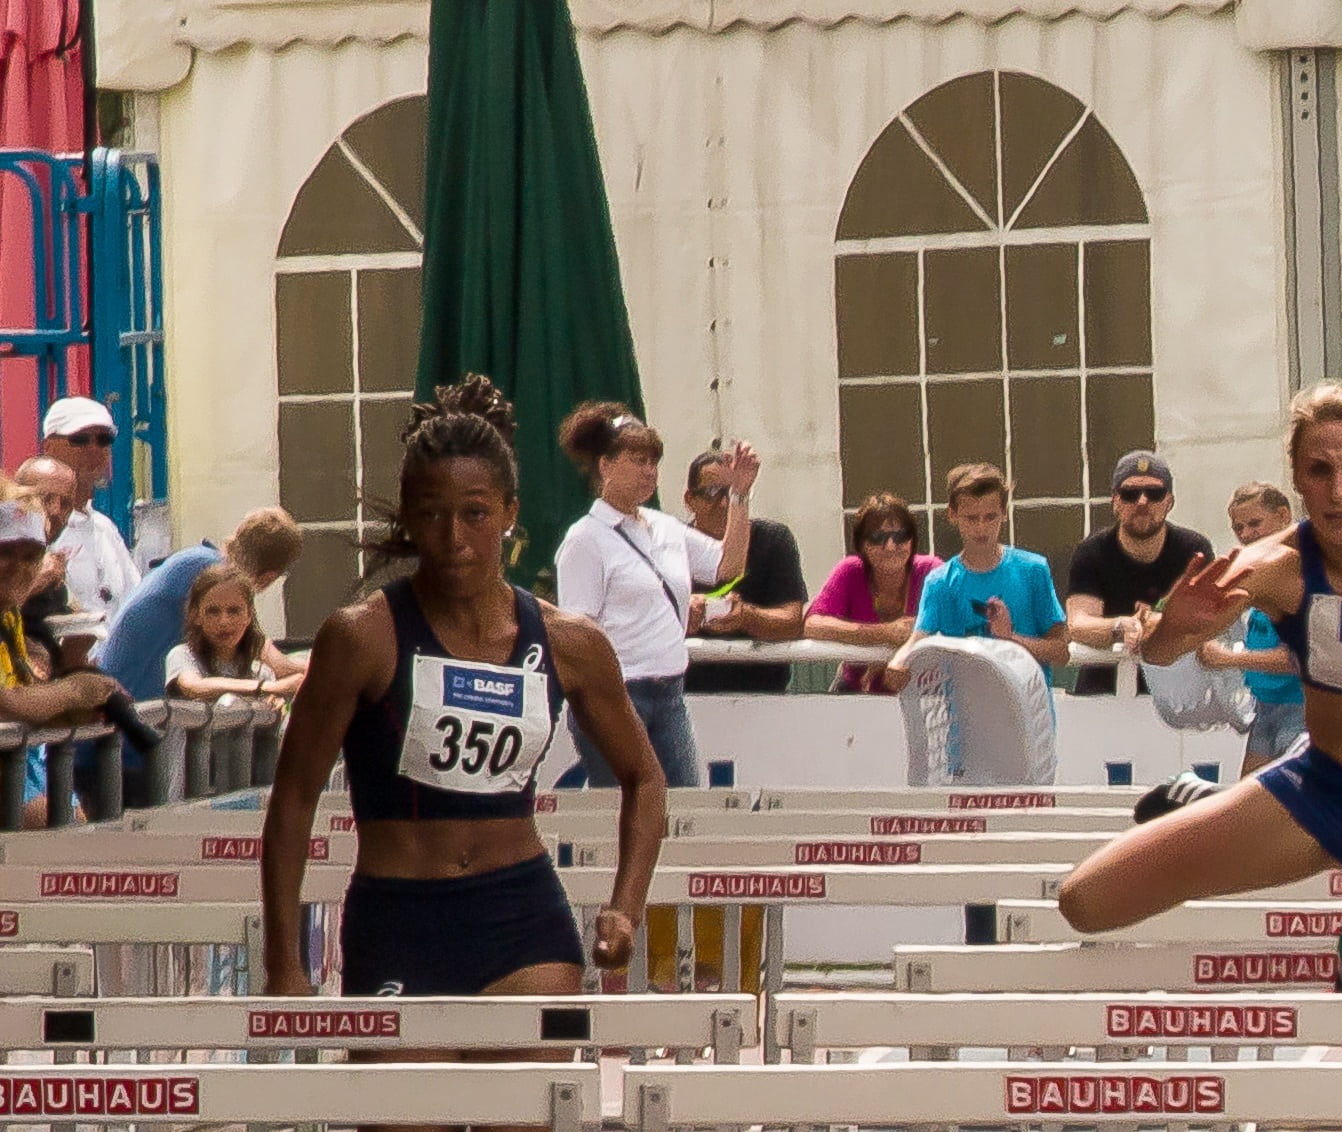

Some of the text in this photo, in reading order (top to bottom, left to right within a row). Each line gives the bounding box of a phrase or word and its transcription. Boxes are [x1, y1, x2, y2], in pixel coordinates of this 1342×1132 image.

[474, 677, 515, 697] BASF
[429, 715, 523, 776] 350
[798, 844, 919, 862] BAUHAUS
[44, 875, 176, 894] BAUHAUS
[691, 876, 824, 895] BAUHAUS
[1197, 956, 1335, 981] BAUHAU
[251, 1014, 397, 1034] BAUHAUS
[1110, 1009, 1293, 1033] BAUHAUS
[1011, 1080, 1220, 1108] BAUHAUS
